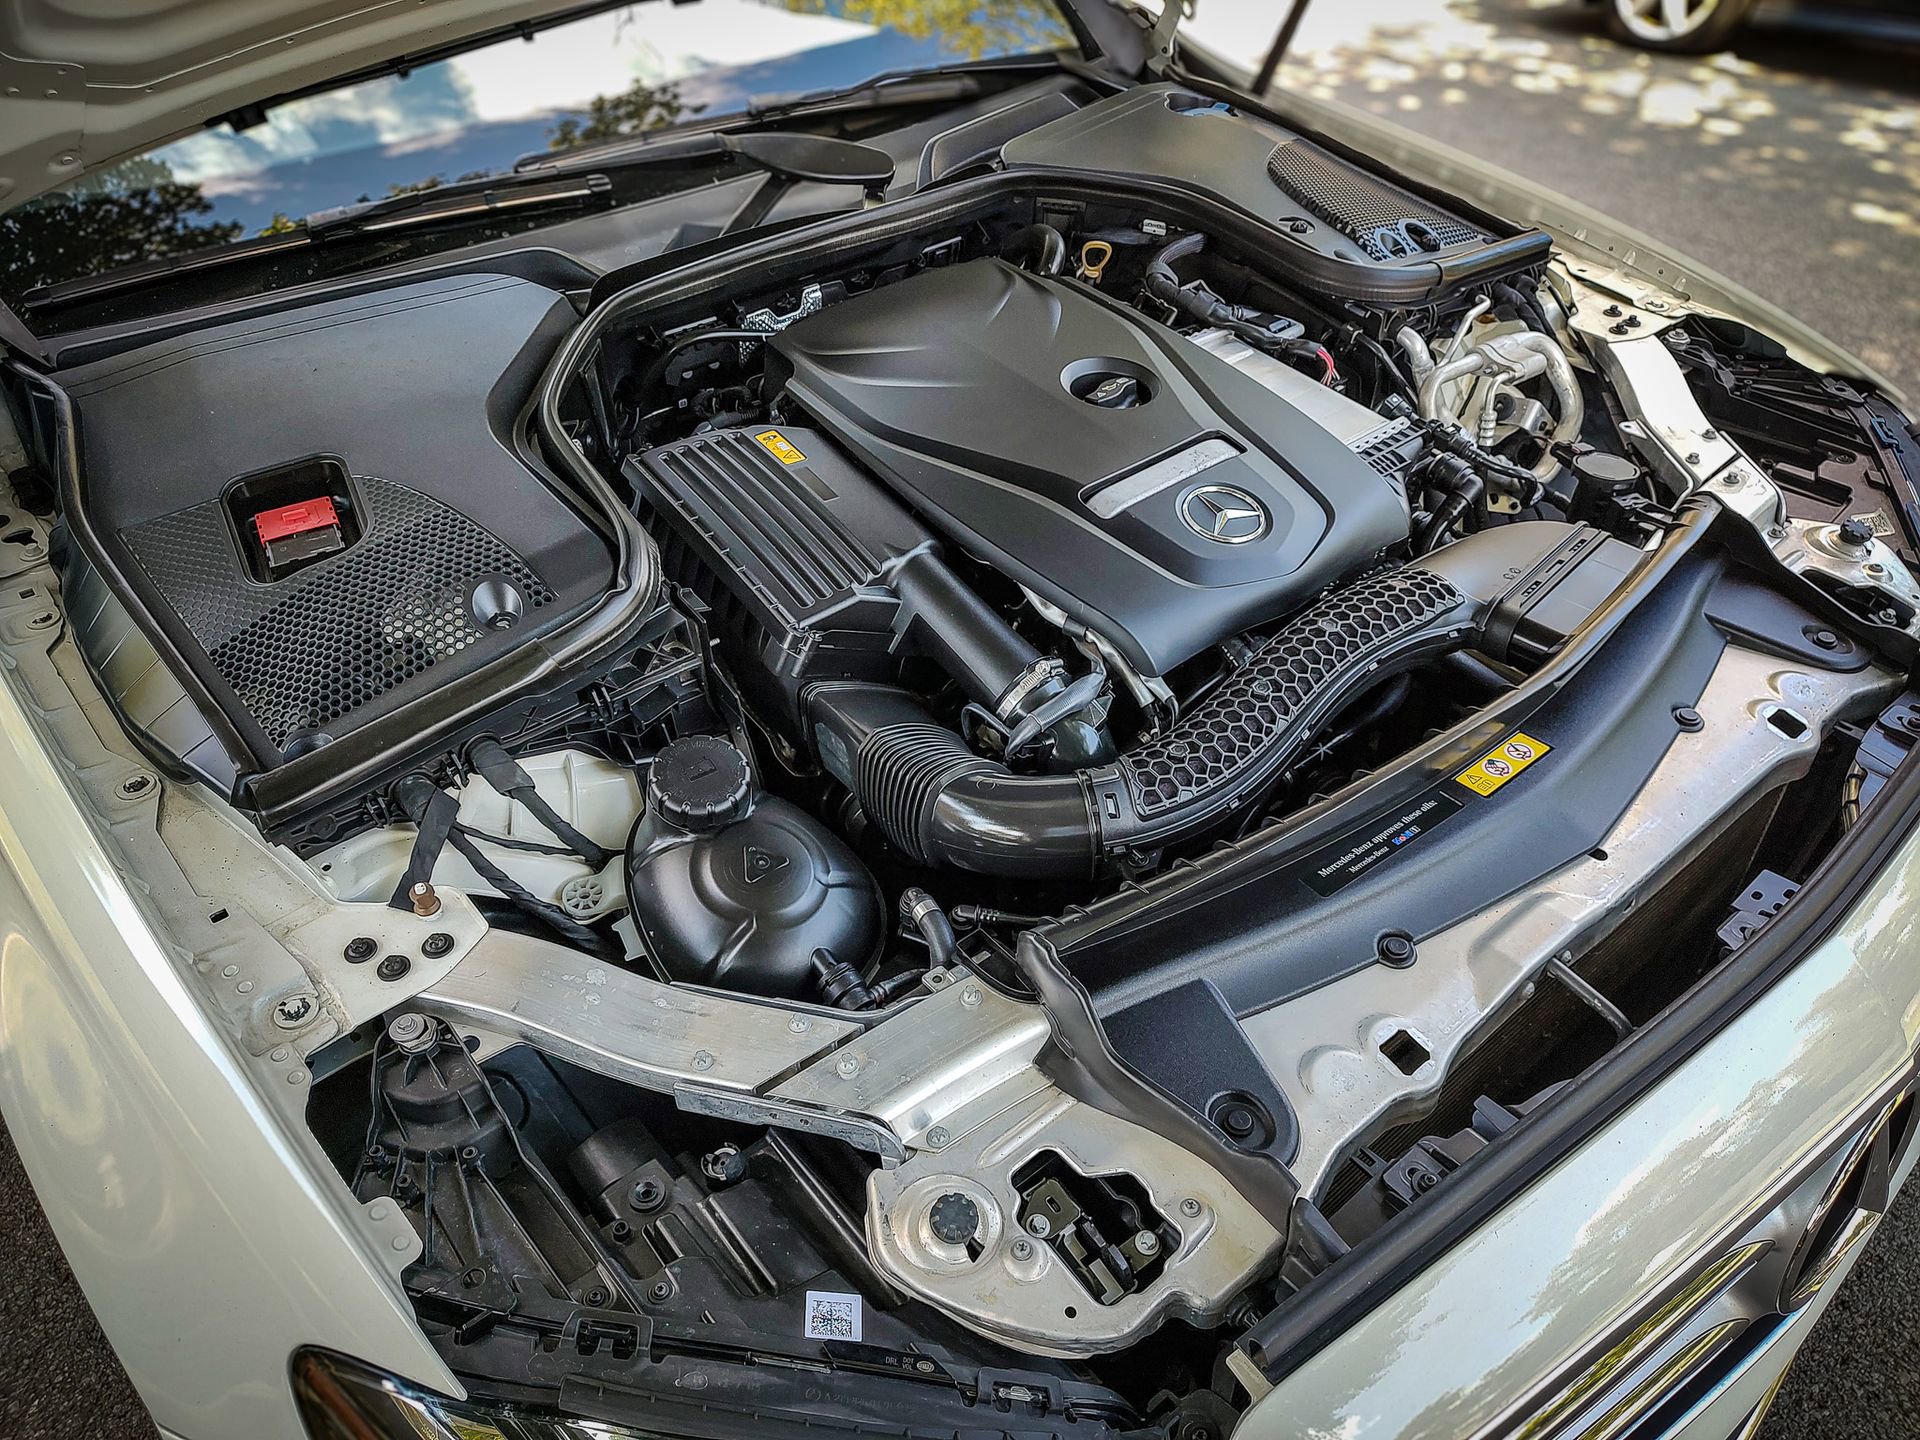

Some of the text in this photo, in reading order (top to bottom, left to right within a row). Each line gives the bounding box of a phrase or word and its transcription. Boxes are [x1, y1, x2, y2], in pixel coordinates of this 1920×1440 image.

[1317, 840, 1374, 878] Mercedes-Benz
[1371, 821, 1404, 844] approves
[1401, 808, 1423, 824] these
[1348, 845, 1390, 874] Mercedes-Benz
